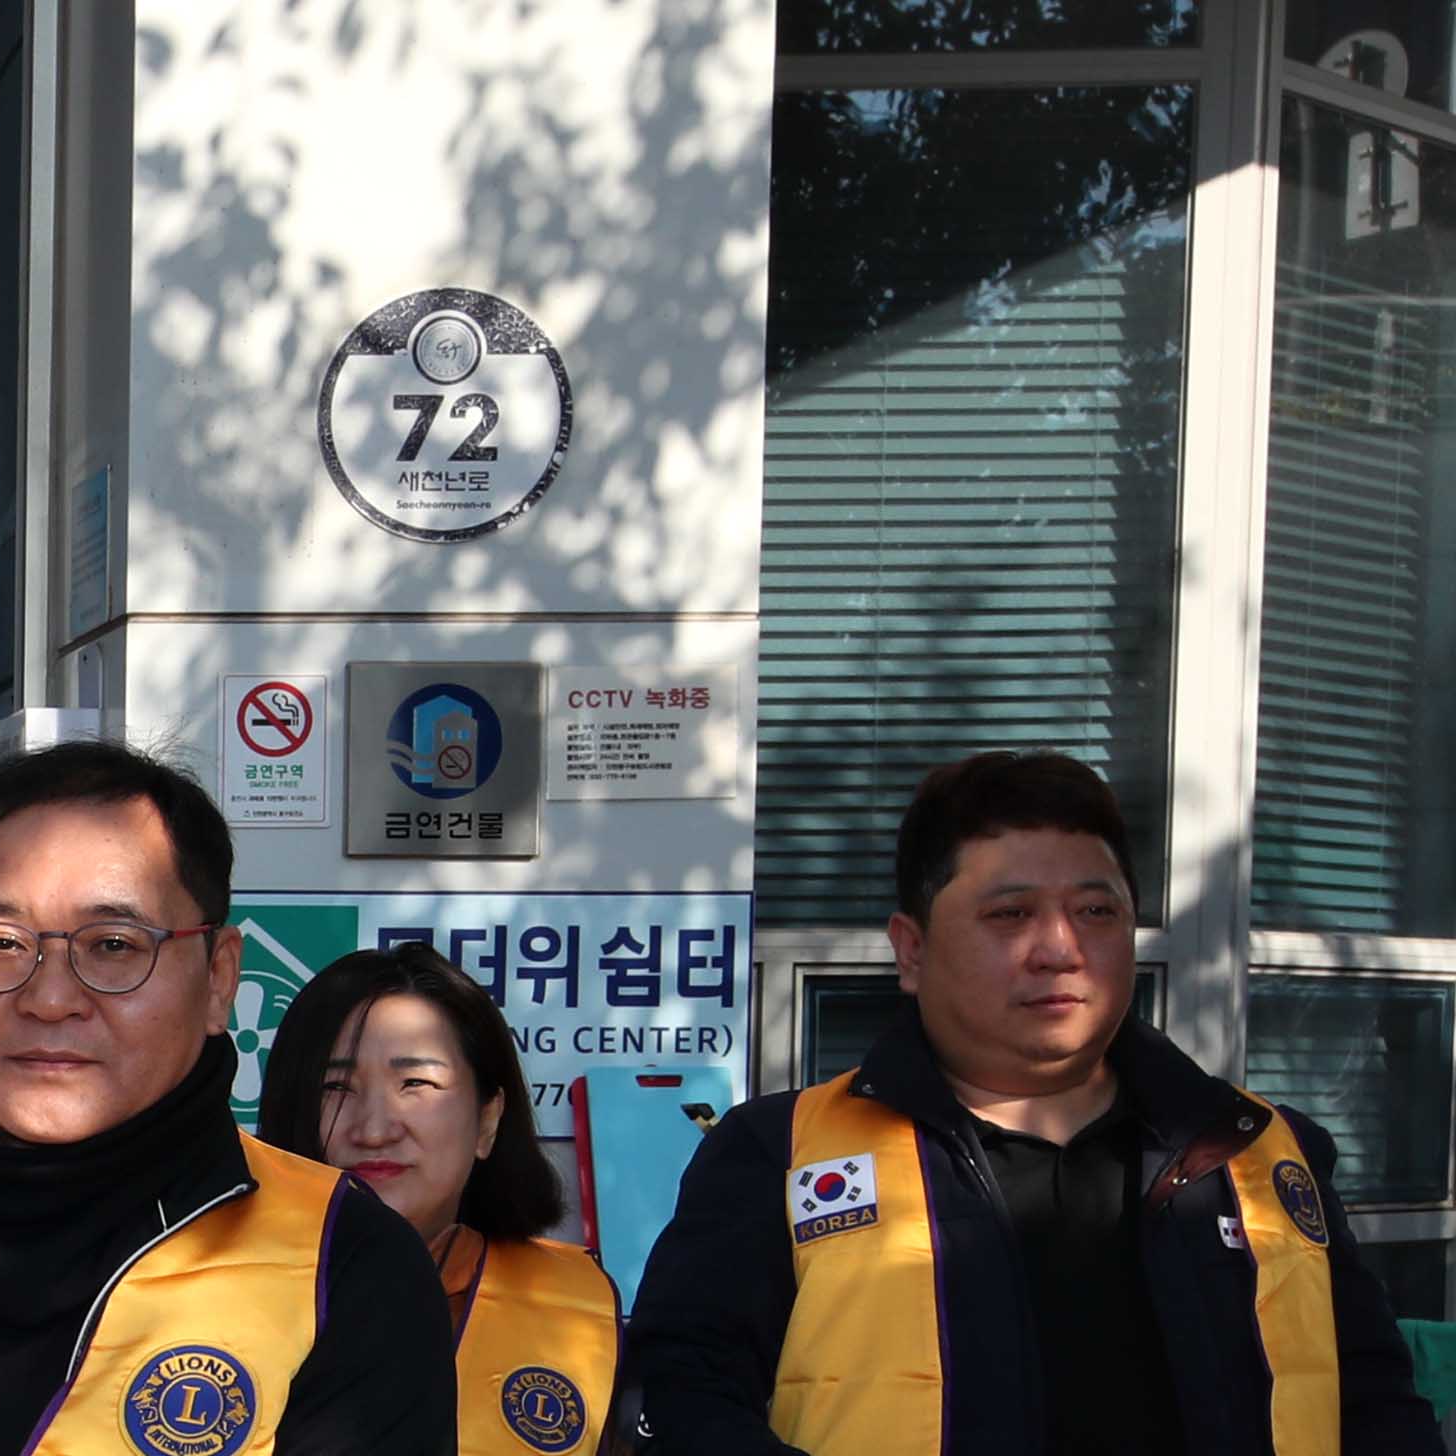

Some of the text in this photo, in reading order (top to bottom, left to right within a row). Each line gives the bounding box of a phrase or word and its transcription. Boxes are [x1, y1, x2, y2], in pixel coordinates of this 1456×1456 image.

[393, 393, 500, 462] 72
[398, 471, 490, 492] 새천년로
[568, 688, 711, 709] CCTV 녹화중
[245, 764, 304, 779] 금연구역
[384, 811, 506, 840] 금연건물
[573, 1024, 734, 1057] CENTER)
[532, 1084, 573, 1107] 77
[800, 1208, 874, 1238] KOREA
[165, 1356, 233, 1383] LIONS
[175, 1384, 207, 1426] L
[534, 1393, 554, 1422] L
